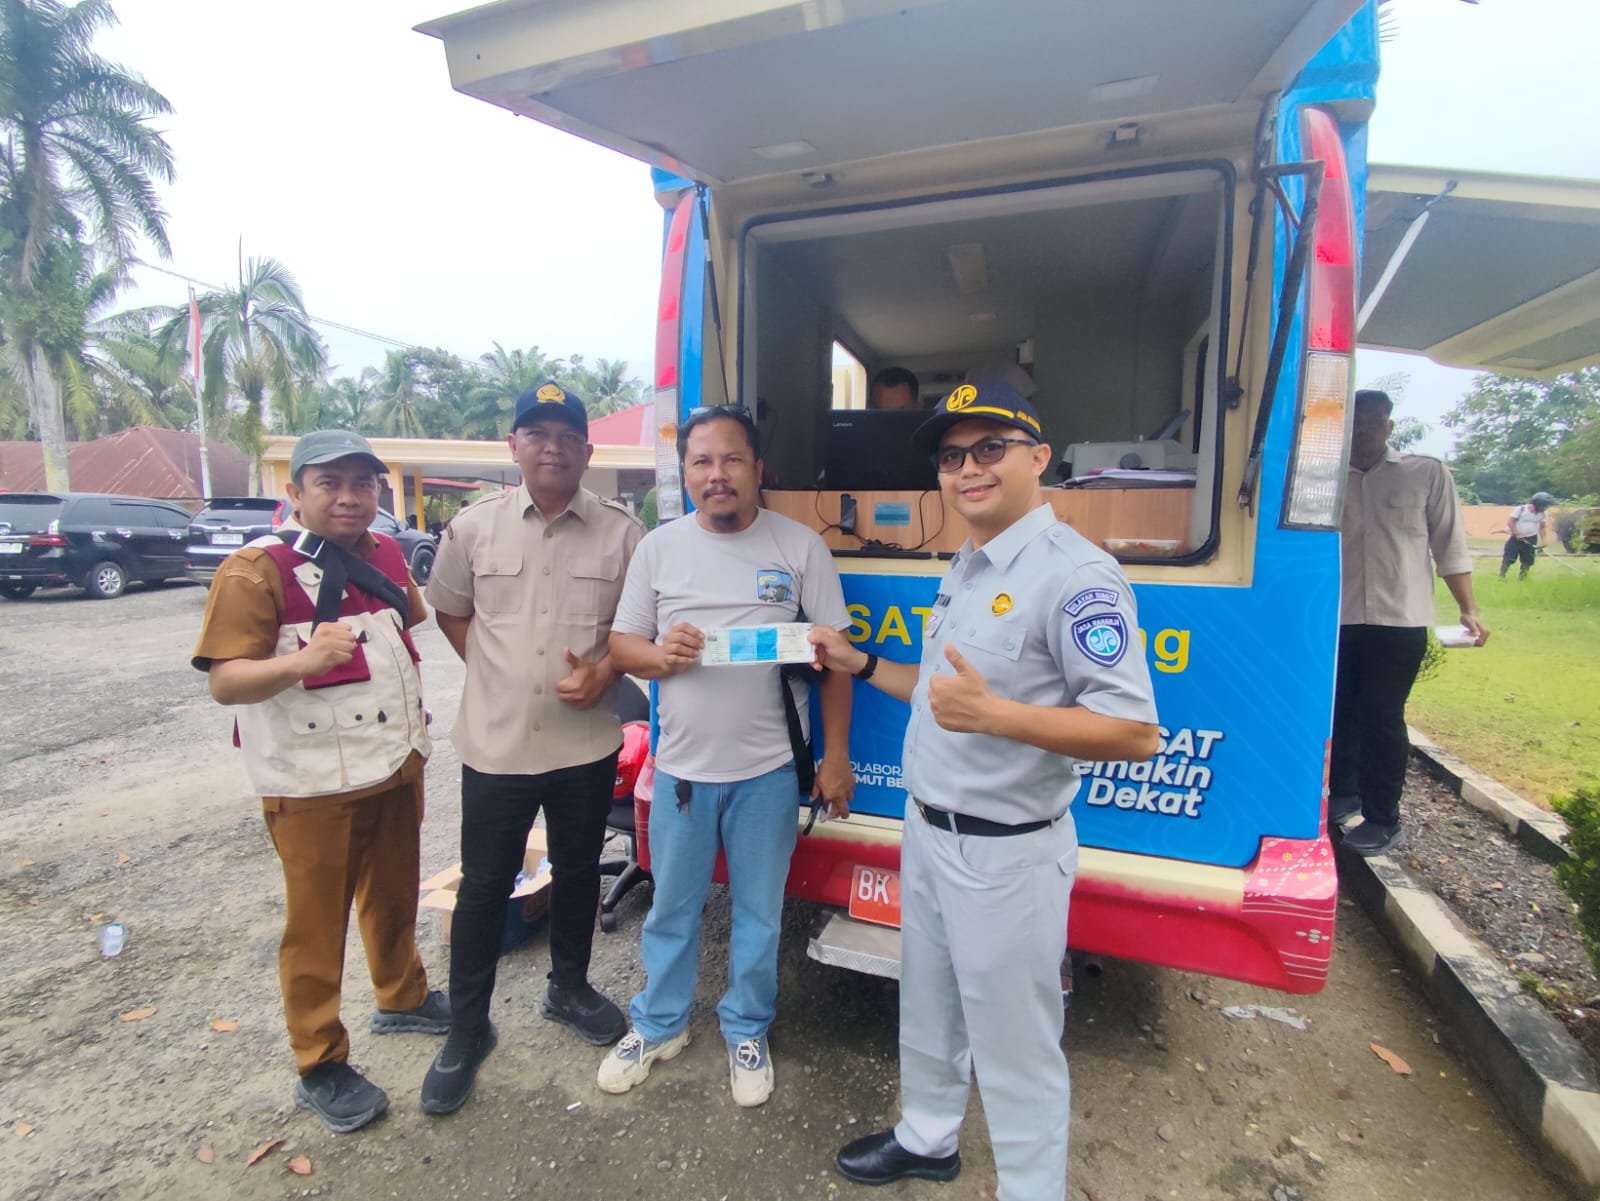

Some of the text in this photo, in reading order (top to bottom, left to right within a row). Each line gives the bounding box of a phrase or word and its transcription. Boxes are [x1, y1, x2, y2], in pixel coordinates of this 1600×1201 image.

[849, 760, 904, 776] OLABOR
[853, 773, 884, 787] MUT
[1087, 777, 1203, 817] Dekat
[858, 869, 890, 905] BK
